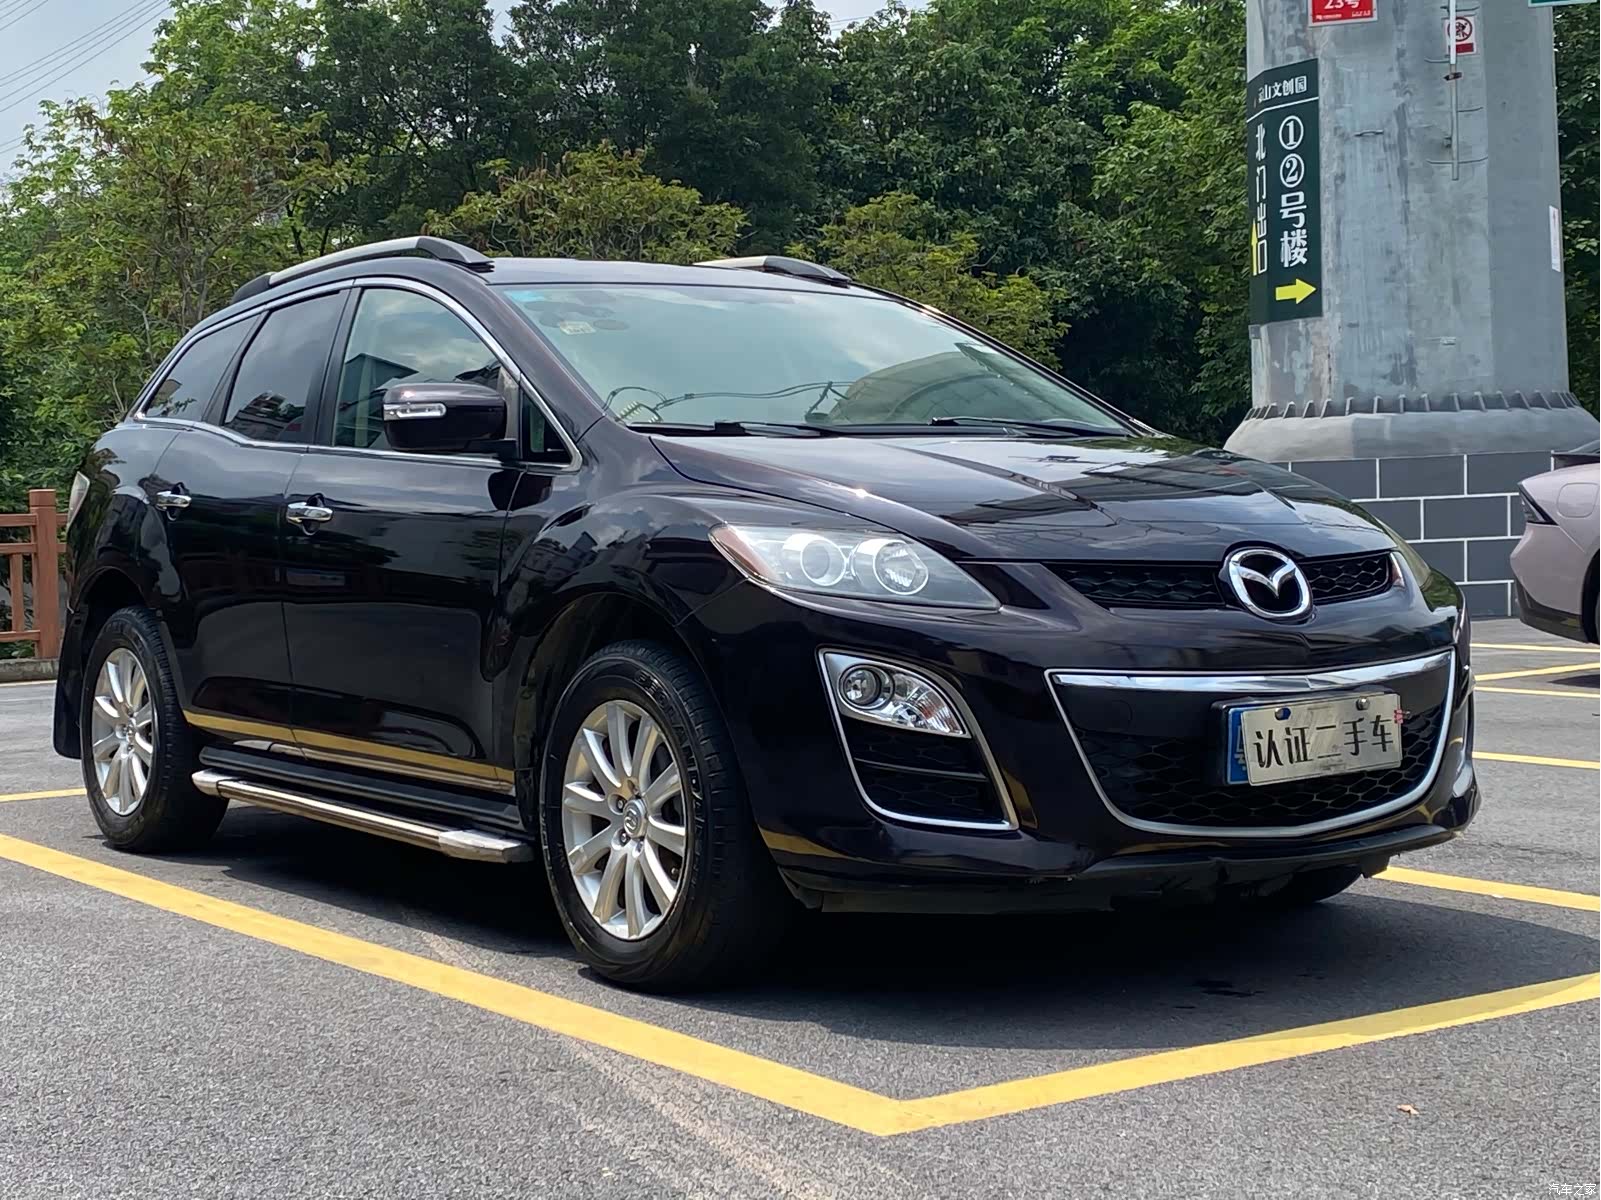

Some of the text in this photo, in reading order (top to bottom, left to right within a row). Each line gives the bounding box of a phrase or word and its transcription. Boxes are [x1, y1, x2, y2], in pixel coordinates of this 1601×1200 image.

[1256, 123, 1267, 274] 北门出口
[1253, 714, 1394, 769] 认证二手车
